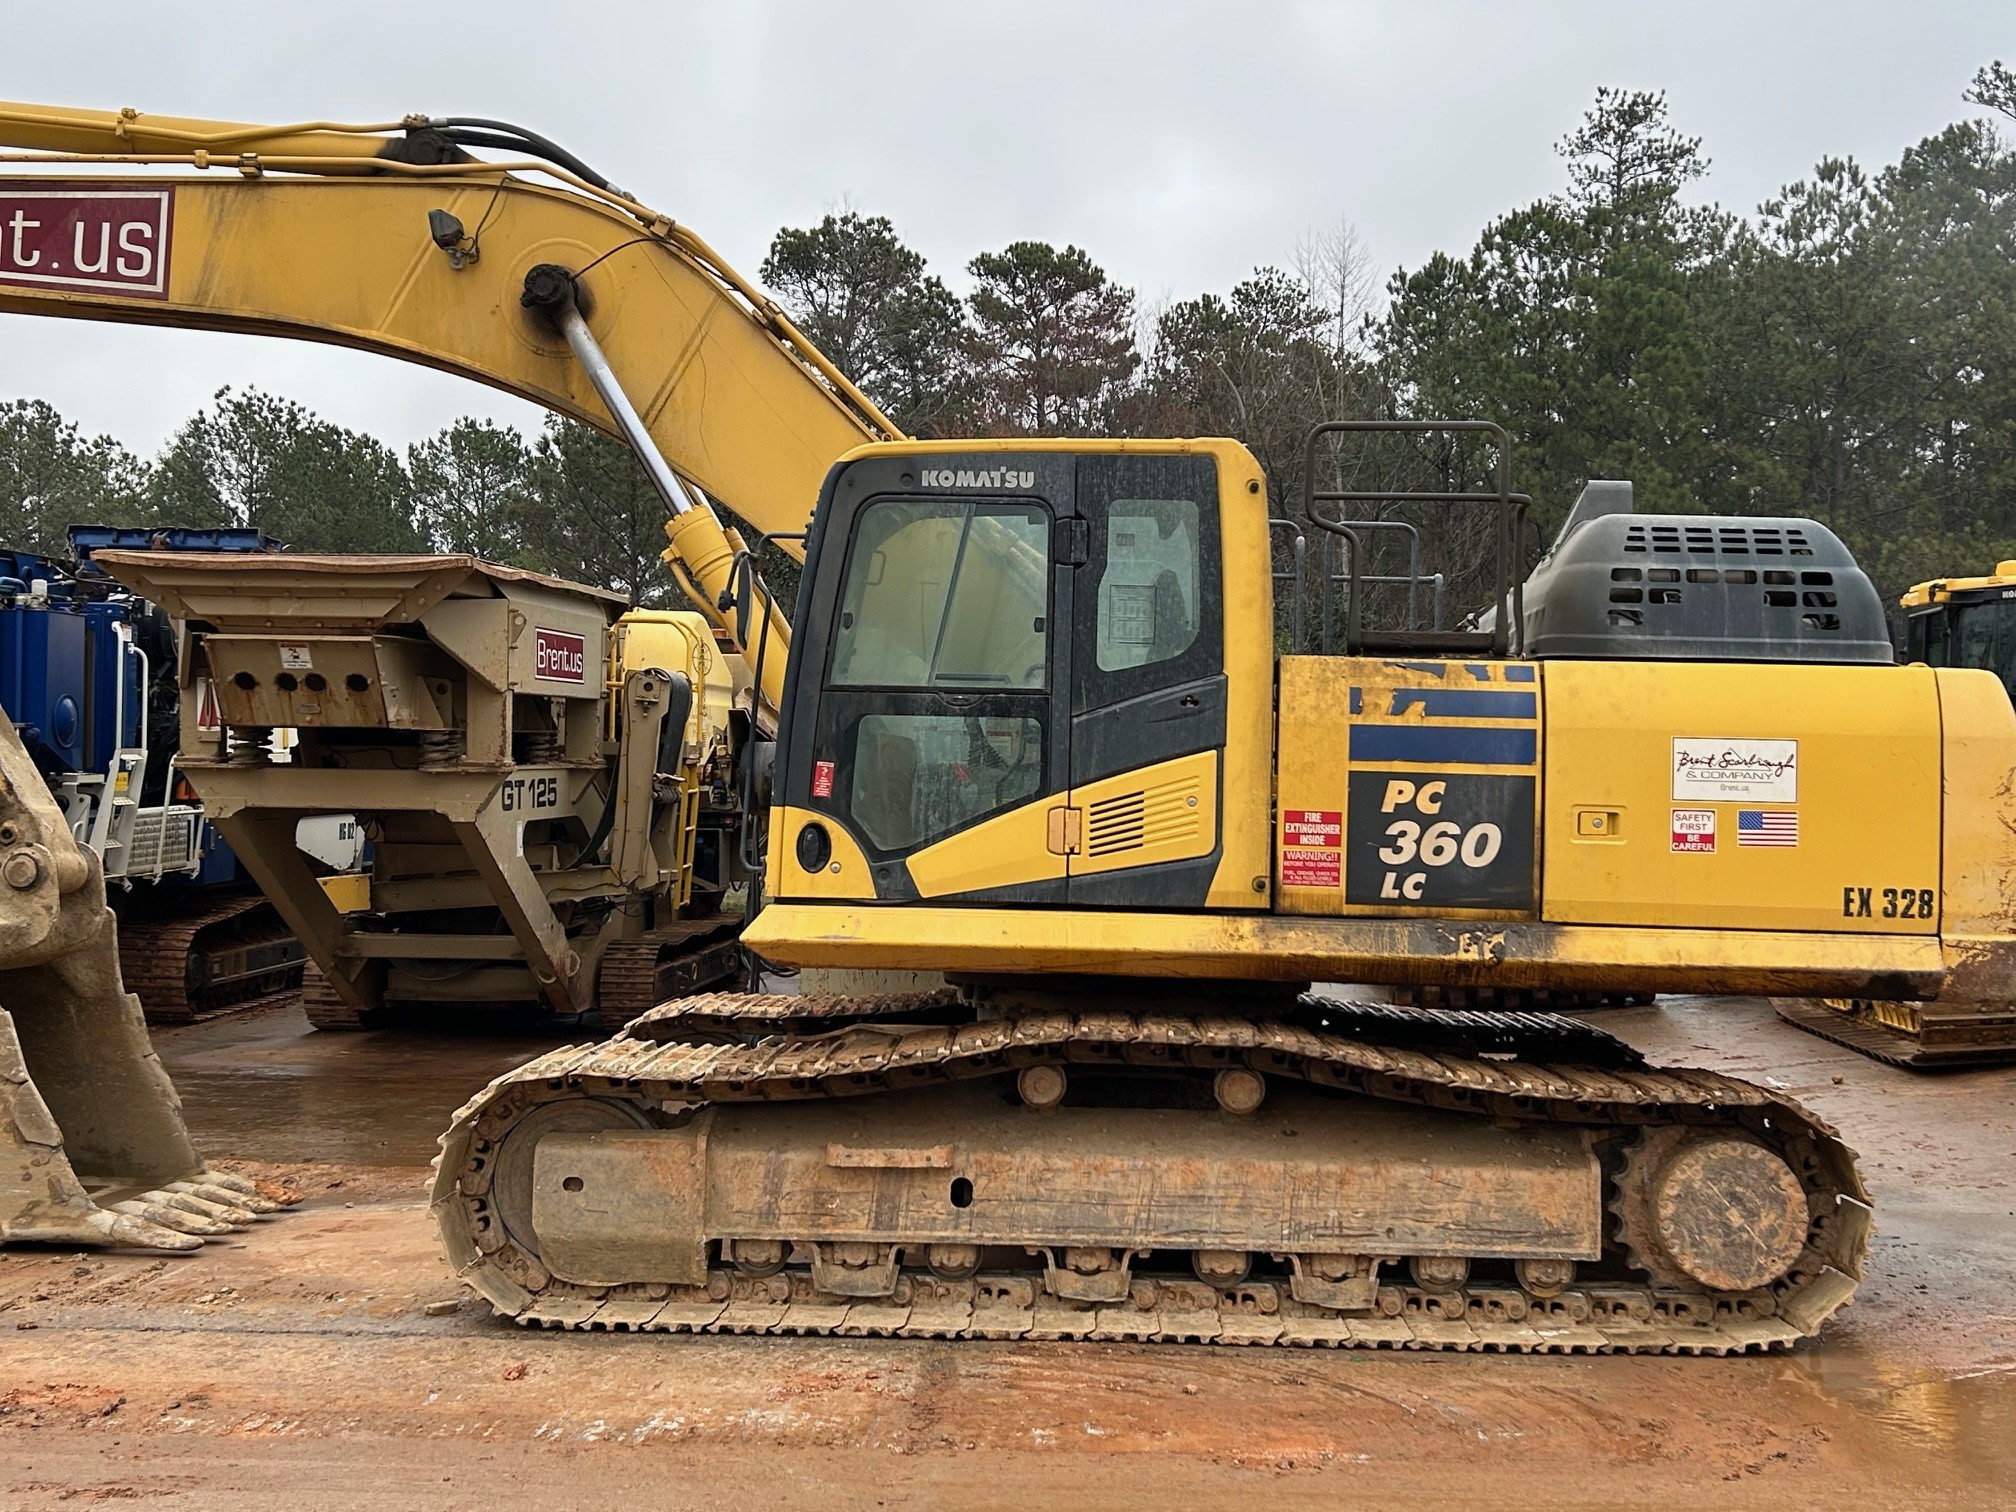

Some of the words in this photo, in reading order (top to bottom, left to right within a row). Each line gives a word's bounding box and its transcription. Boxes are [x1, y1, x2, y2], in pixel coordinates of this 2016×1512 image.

[0, 210, 152, 277] t.us
[921, 466, 1035, 489] KOMATSU
[2002, 590, 2016, 598] KO
[537, 638, 583, 674] Brent.us
[1676, 750, 1716, 772] Brent
[1686, 770, 1698, 779] &
[1700, 770, 1774, 780] COMPANY
[502, 779, 525, 811] GT
[528, 777, 557, 809] 125
[1380, 780, 1447, 815] PC
[1304, 812, 1323, 823] FIRE
[1675, 813, 1713, 822] SAFETY
[1285, 823, 1341, 835] EXTINGUISHER
[1679, 822, 1708, 831] FIRST
[1299, 834, 1326, 846] INSIDE
[1378, 820, 1502, 868] 360
[1686, 834, 1701, 842] BE
[1672, 842, 1715, 851] CAREFUL
[1286, 851, 1338, 861] WARNING!!
[1380, 871, 1427, 900] LC
[1843, 887, 1873, 917] EX
[1882, 888, 1934, 919] 328
